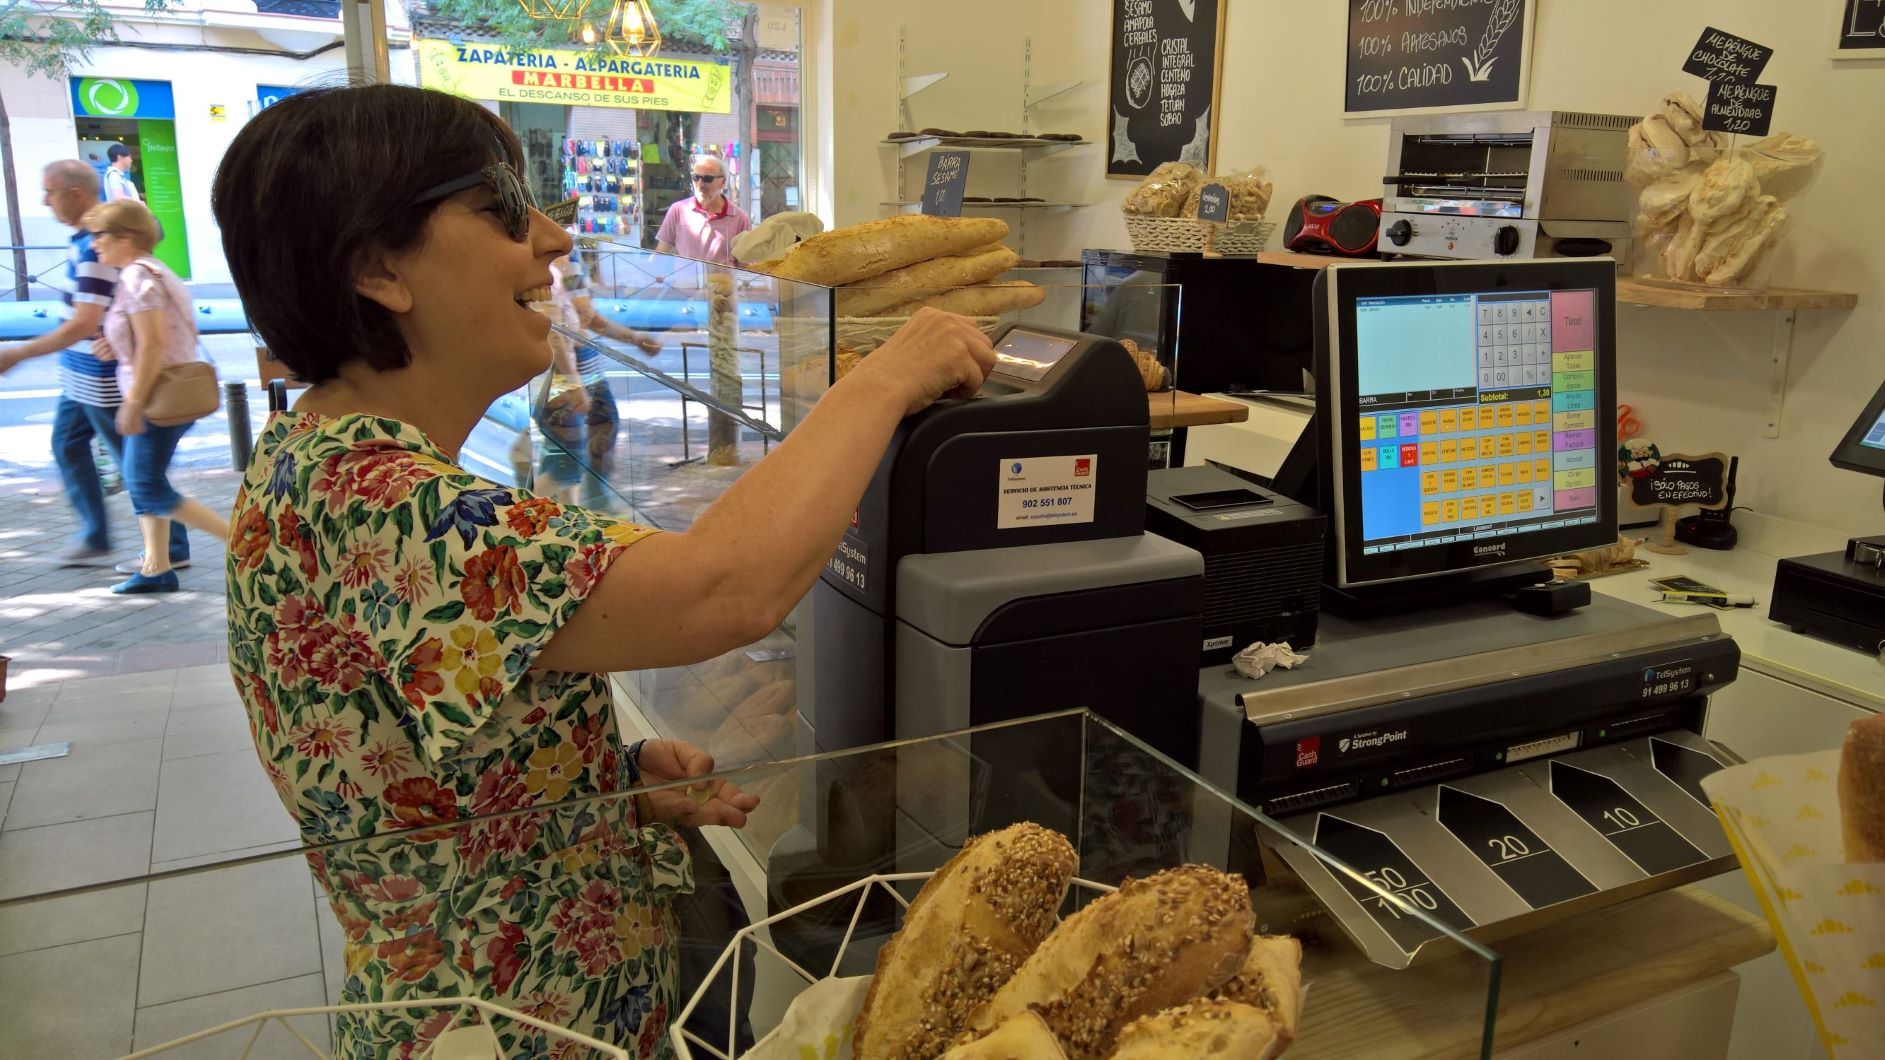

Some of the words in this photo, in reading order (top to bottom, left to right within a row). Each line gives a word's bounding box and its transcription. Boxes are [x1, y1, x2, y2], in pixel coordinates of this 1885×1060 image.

[1360, 0, 1398, 22] 100%
[1124, 29, 1158, 47] CEREALES
[1161, 37, 1190, 55] CRISTAL
[1358, 35, 1392, 59] 100%
[1401, 25, 1467, 53] ARTESANOS
[457, 48, 557, 69] ZAPATERIA
[575, 57, 700, 79] ALPARGATERIA
[1162, 54, 1195, 69] INTEGRAL
[1692, 50, 1751, 77] CHOCOLATE
[522, 71, 645, 92] MARBELLA
[1161, 68, 1191, 83] CENTENO
[1356, 70, 1394, 95] 100%
[498, 88, 515, 97] EL
[519, 89, 591, 101] DESCANSO
[594, 94, 611, 102] DE
[614, 95, 639, 104] SUS
[642, 97, 669, 106] PIES
[1160, 83, 1186, 99] HOGAZA
[1160, 113, 1182, 126] SOBAO
[1711, 104, 1762, 118] ALMENDRAS
[1724, 117, 1751, 131] 1,20
[1564, 316, 1582, 326] Total
[1359, 396, 1378, 405] BARRA
[1480, 392, 1509, 402] Subtotal:
[1537, 388, 1550, 398] 1,30
[1676, 480, 1699, 492] PAGOS
[1022, 500, 1037, 508] 902
[1040, 499, 1055, 507] 551
[1057, 497, 1073, 506] 807
[1658, 491, 1671, 499] EN
[1473, 542, 1506, 554] Concord
[833, 558, 846, 577] 499
[845, 565, 855, 583] 96
[855, 571, 866, 589] 13
[1655, 666, 1692, 680] TelSystem
[1642, 687, 1652, 698] 91
[1653, 683, 1668, 695] 499
[1669, 681, 1679, 692] 96
[1680, 679, 1689, 689] 13
[1352, 730, 1407, 750] StrongPoint
[1296, 756, 1318, 767] Guard
[1299, 750, 1317, 760] Cash
[1603, 807, 1640, 829] 10
[1488, 835, 1530, 861] 20
[1364, 867, 1407, 891] 50
[1378, 888, 1438, 919] 100
